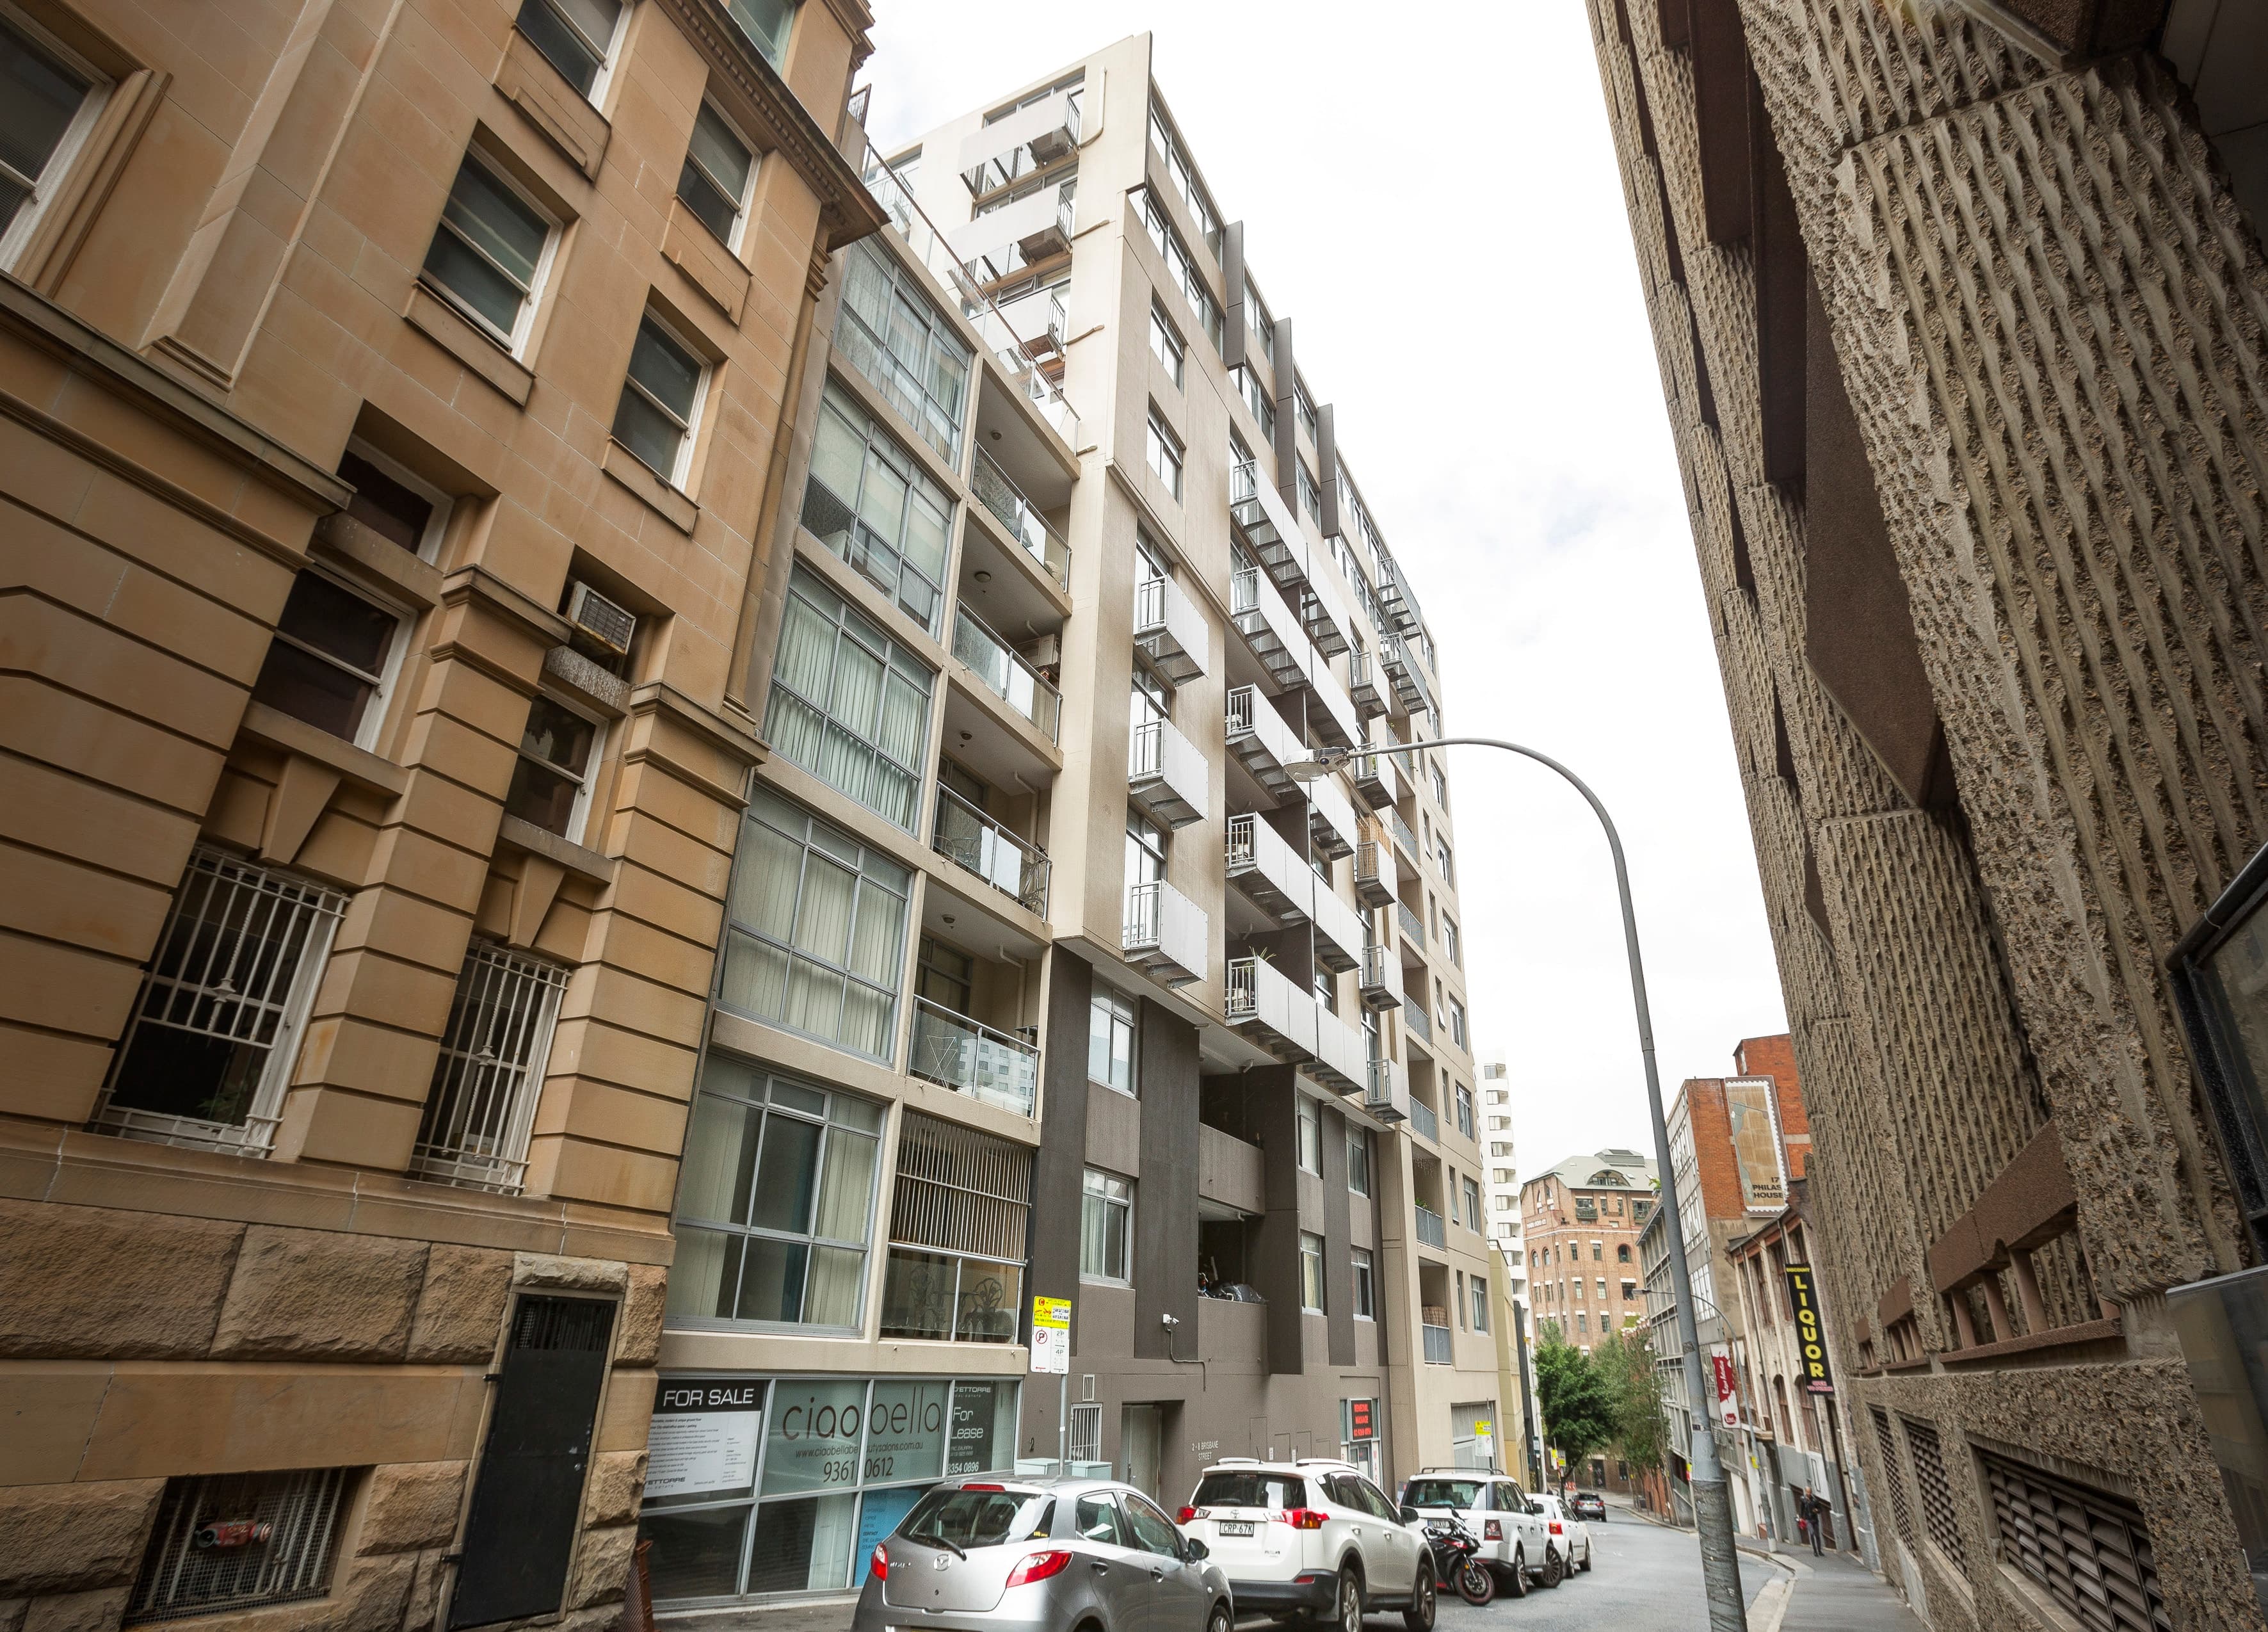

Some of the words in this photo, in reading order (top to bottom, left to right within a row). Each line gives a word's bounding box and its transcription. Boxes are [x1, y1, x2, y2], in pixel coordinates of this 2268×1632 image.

[1794, 1275, 1824, 1378] LIQUOR
[663, 1390, 704, 1407] FOR
[708, 1388, 754, 1405] SALE
[783, 1396, 860, 1441] ciao
[870, 1386, 941, 1435] bella
[953, 1407, 974, 1421] For
[951, 1425, 984, 1439] Lease
[1029, 1437, 1034, 1452] 2
[1201, 1440, 1219, 1450] BRISBANE
[1198, 1451, 1212, 1461] STREET
[823, 1460, 855, 1482] 9361
[865, 1457, 894, 1478] 0612
[963, 1461, 979, 1473] 0896
